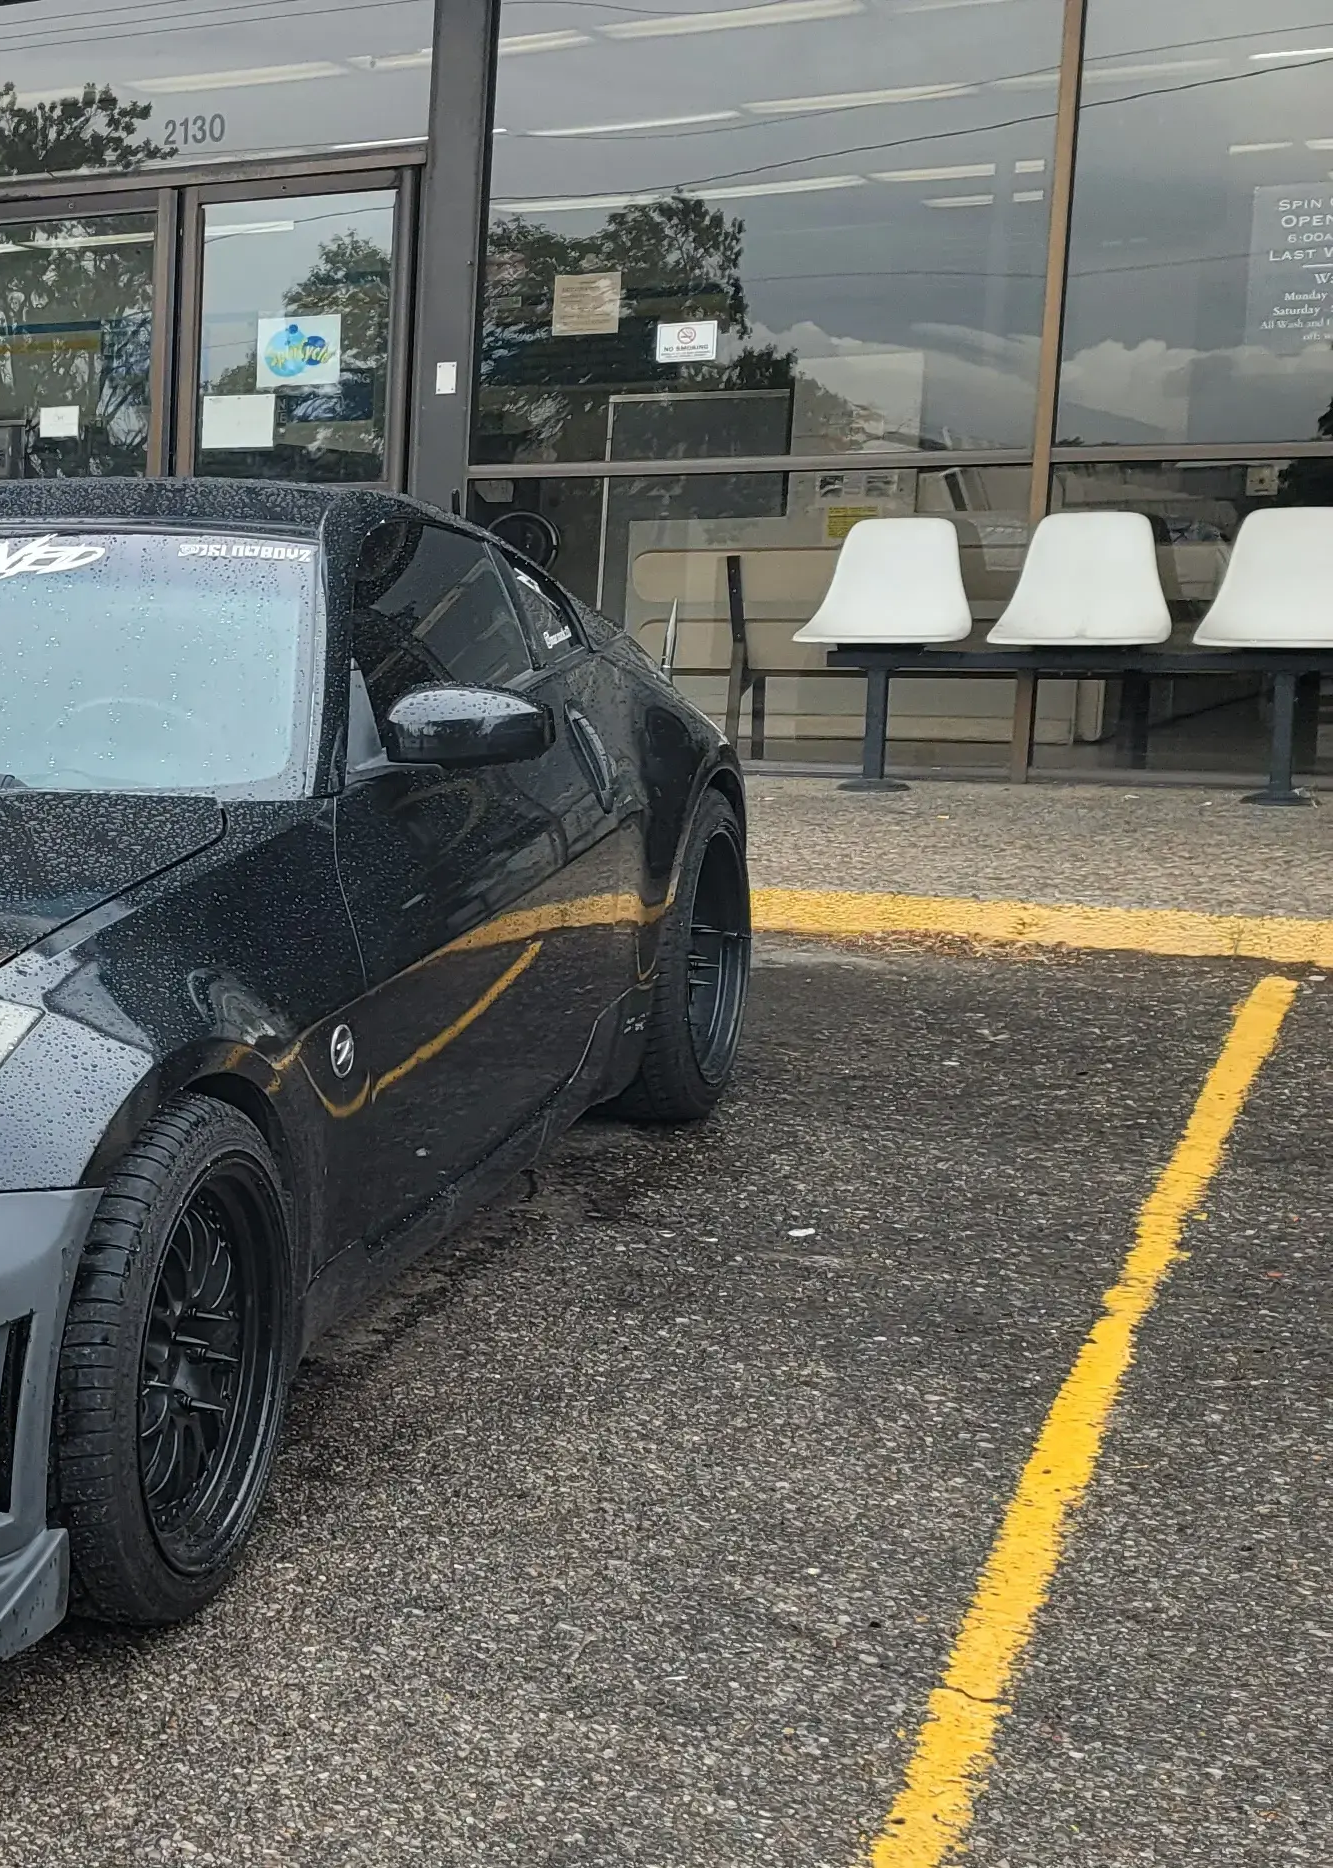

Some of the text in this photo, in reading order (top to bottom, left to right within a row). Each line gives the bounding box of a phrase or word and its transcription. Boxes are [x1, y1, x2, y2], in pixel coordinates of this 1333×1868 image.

[163, 113, 225, 146] 2130
[1287, 232, 1333, 243] 6:00A
[1269, 249, 1317, 261] LAST
[1284, 290, 1328, 301] Monday
[1273, 303, 1321, 316] Saturday
